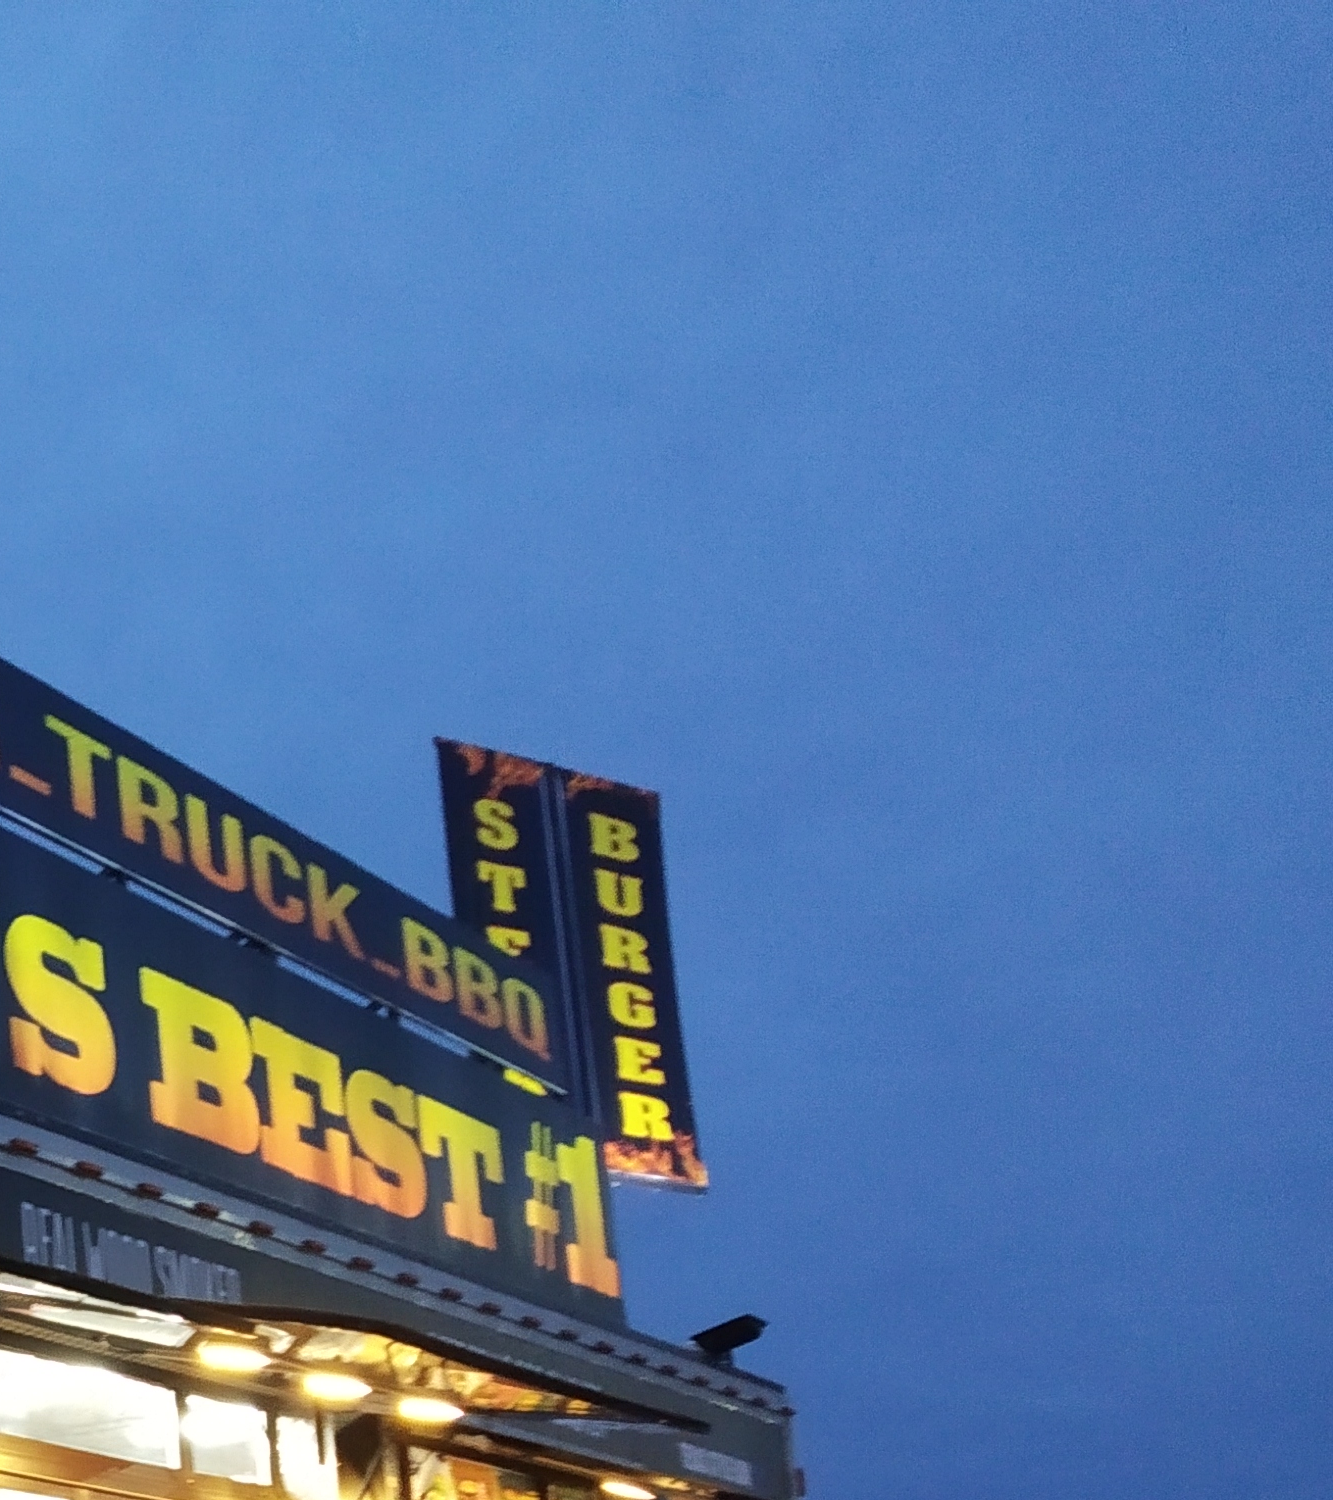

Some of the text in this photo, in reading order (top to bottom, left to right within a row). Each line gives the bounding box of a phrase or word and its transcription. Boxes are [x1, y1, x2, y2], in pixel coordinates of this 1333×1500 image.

[138, 966, 504, 1250] BEST
[524, 1120, 621, 1298] #1
[587, 812, 674, 1141] BURGER
